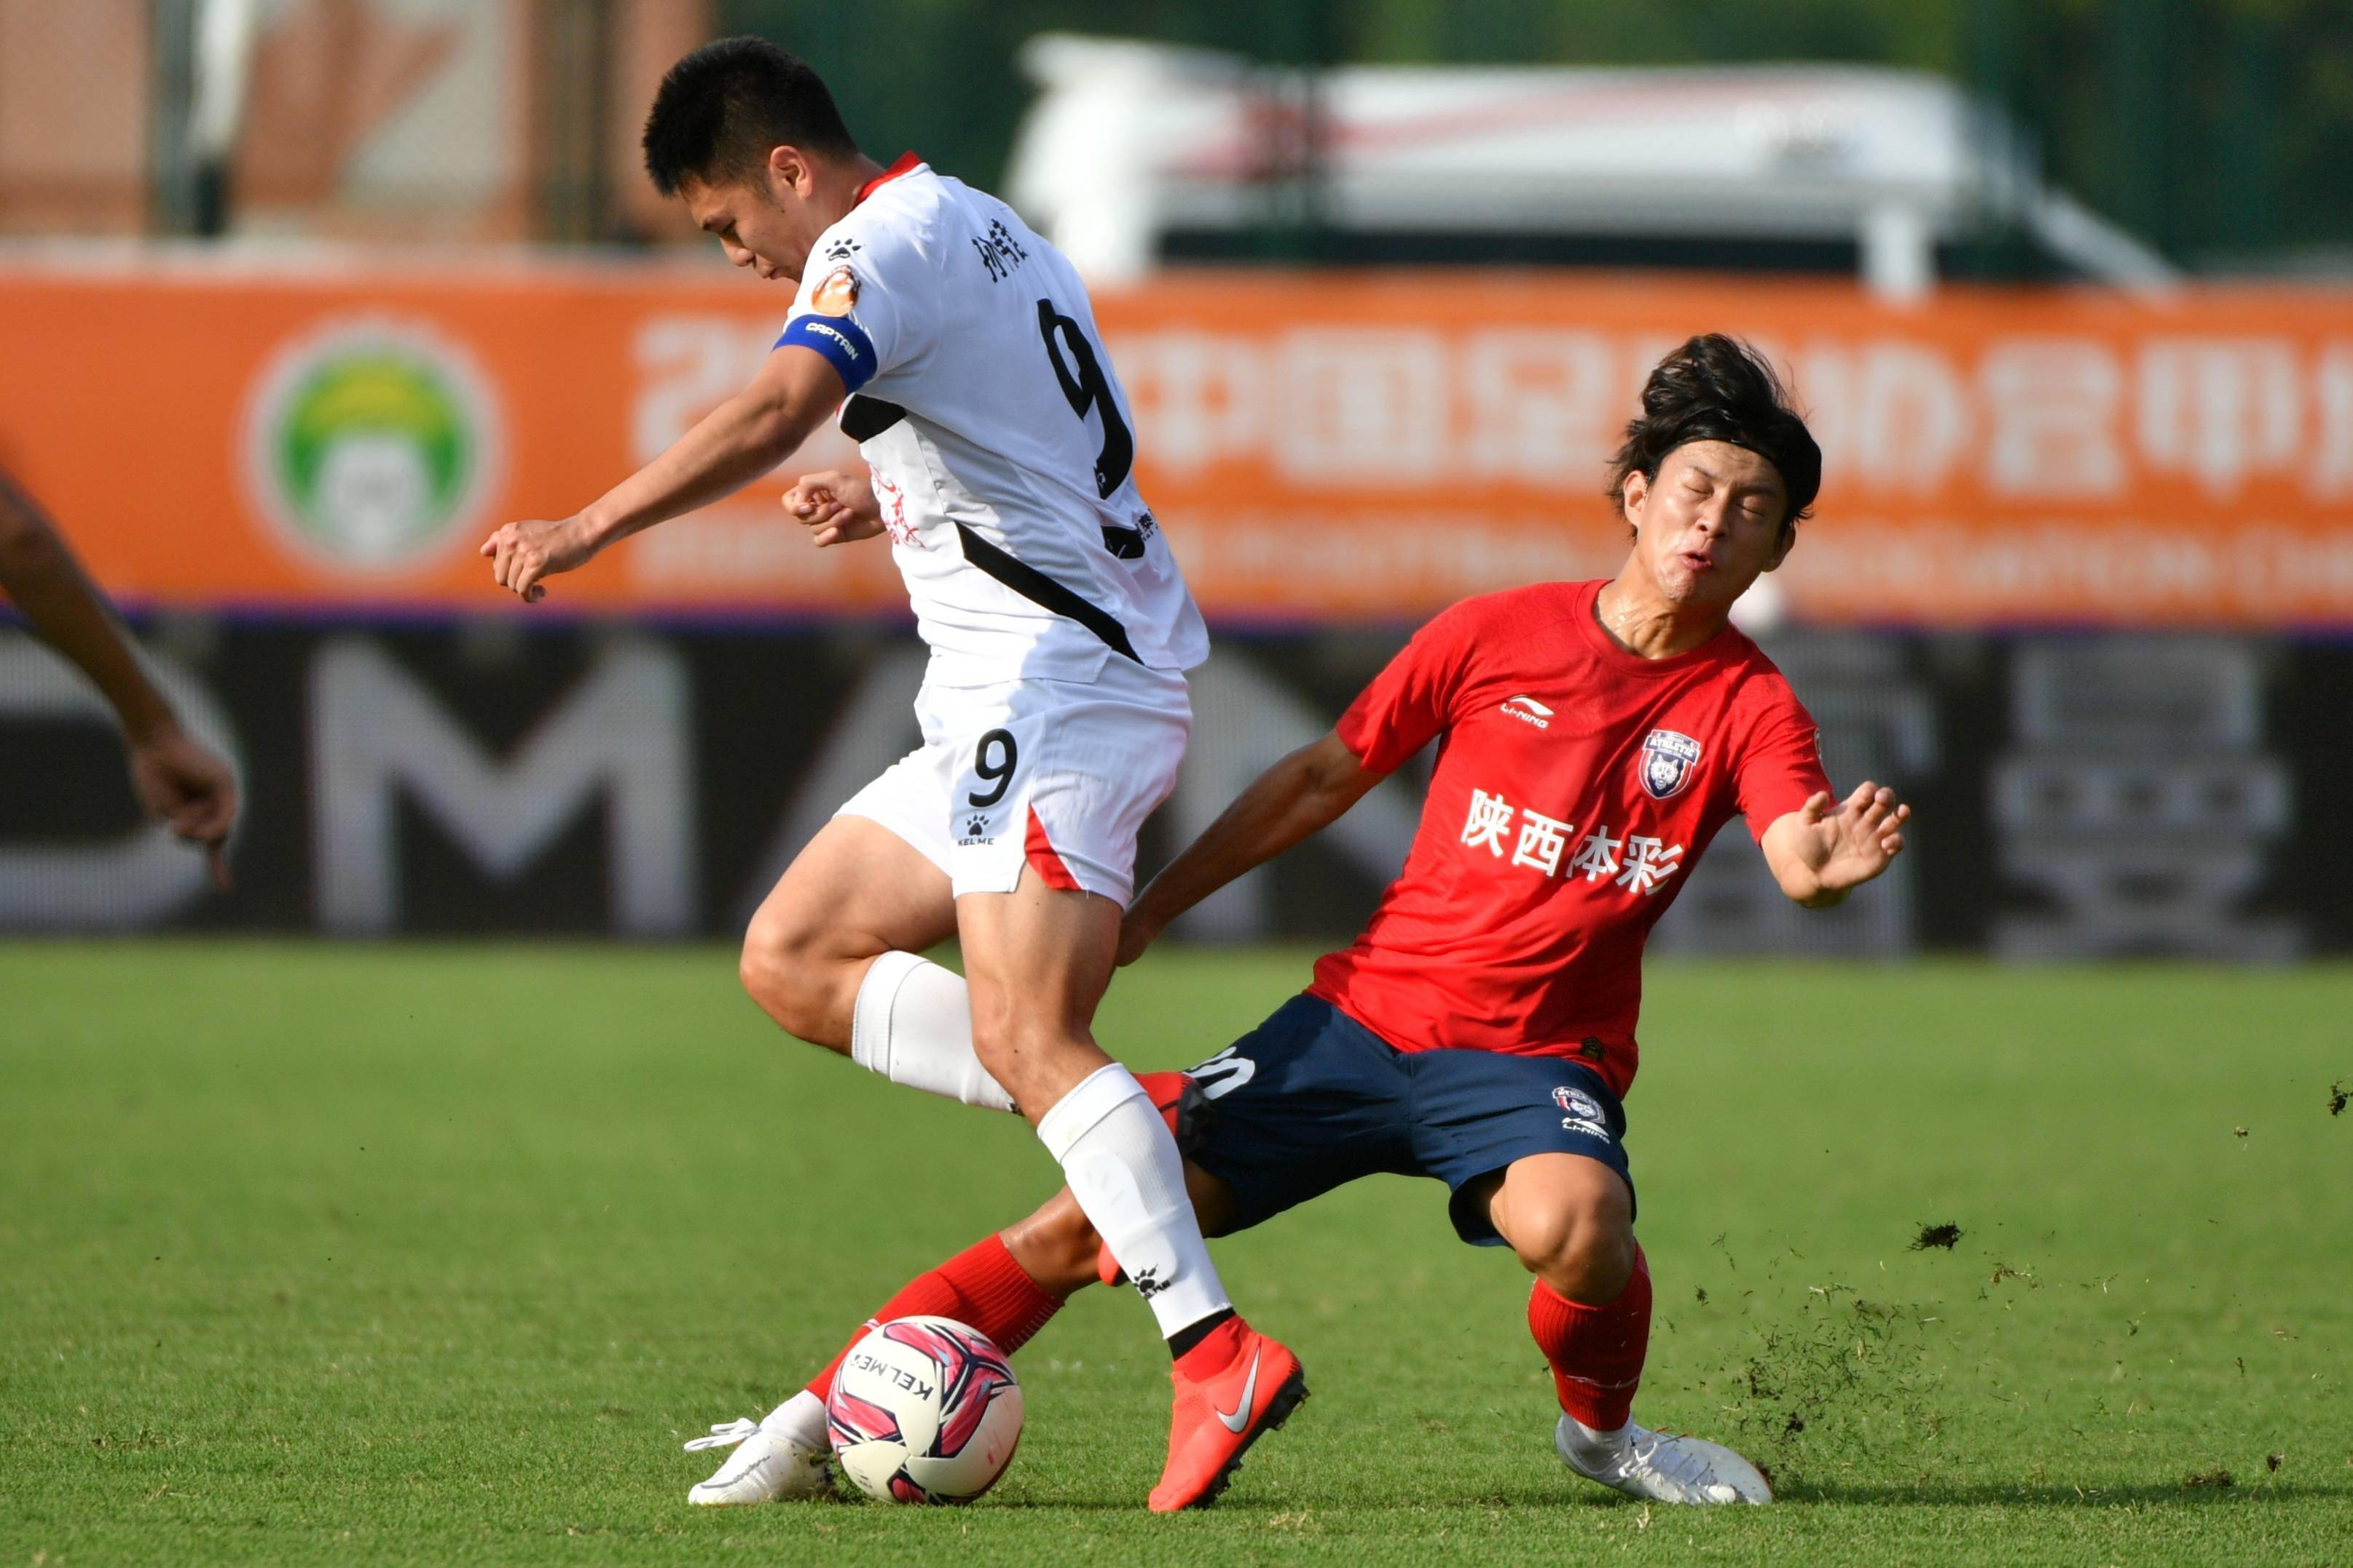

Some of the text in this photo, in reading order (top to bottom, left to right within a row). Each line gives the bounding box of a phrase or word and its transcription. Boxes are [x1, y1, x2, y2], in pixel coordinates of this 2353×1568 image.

[806, 323, 858, 361] CAPTAIN
[1037, 298, 1134, 500] 9
[1501, 703, 1549, 729] LI-NING
[968, 728, 1018, 808] 9
[957, 837, 995, 847] KELME
[1461, 788, 1684, 896] 陕西体彩
[857, 1355, 934, 1401] KELME
